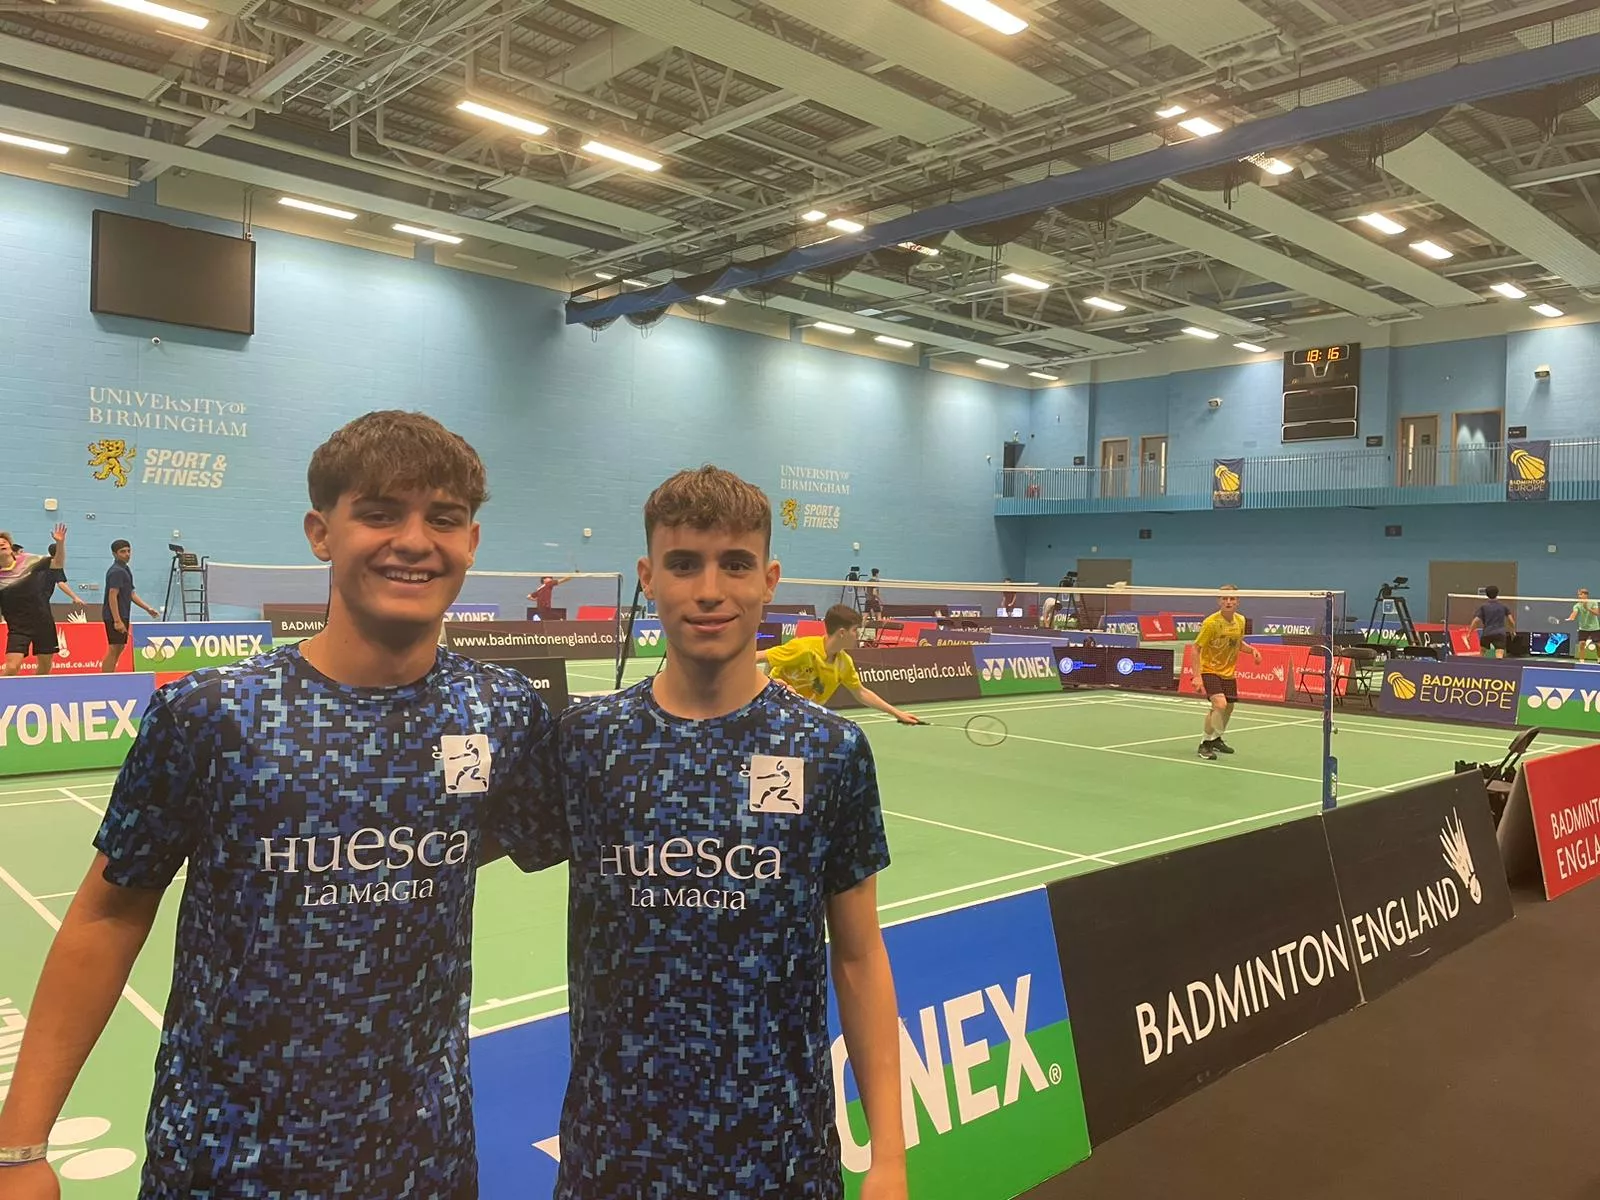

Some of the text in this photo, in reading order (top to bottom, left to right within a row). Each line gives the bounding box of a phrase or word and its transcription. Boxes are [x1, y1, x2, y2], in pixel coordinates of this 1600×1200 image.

[1306, 346, 1340, 362] 18:16
[88, 407, 248, 437] BIRMINGHAM
[144, 448, 227, 472] SPORT &
[142, 468, 225, 488] FITNESS
[780, 478, 850, 495] BIRMINGHAM
[804, 504, 833, 517] SPORT
[803, 516, 839, 529] FITNESS
[281, 621, 326, 631] BADMIN
[1282, 624, 1312, 635] YONEX
[190, 634, 263, 657] YONEX
[1008, 657, 1053, 679] YONEX
[1422, 674, 1516, 692] BADMINTON
[1420, 686, 1512, 709] EUROPE
[0, 699, 138, 747] YONEX
[1550, 797, 1600, 840] BADMINT
[1135, 876, 1460, 1066] BADMINTON ENGLAND
